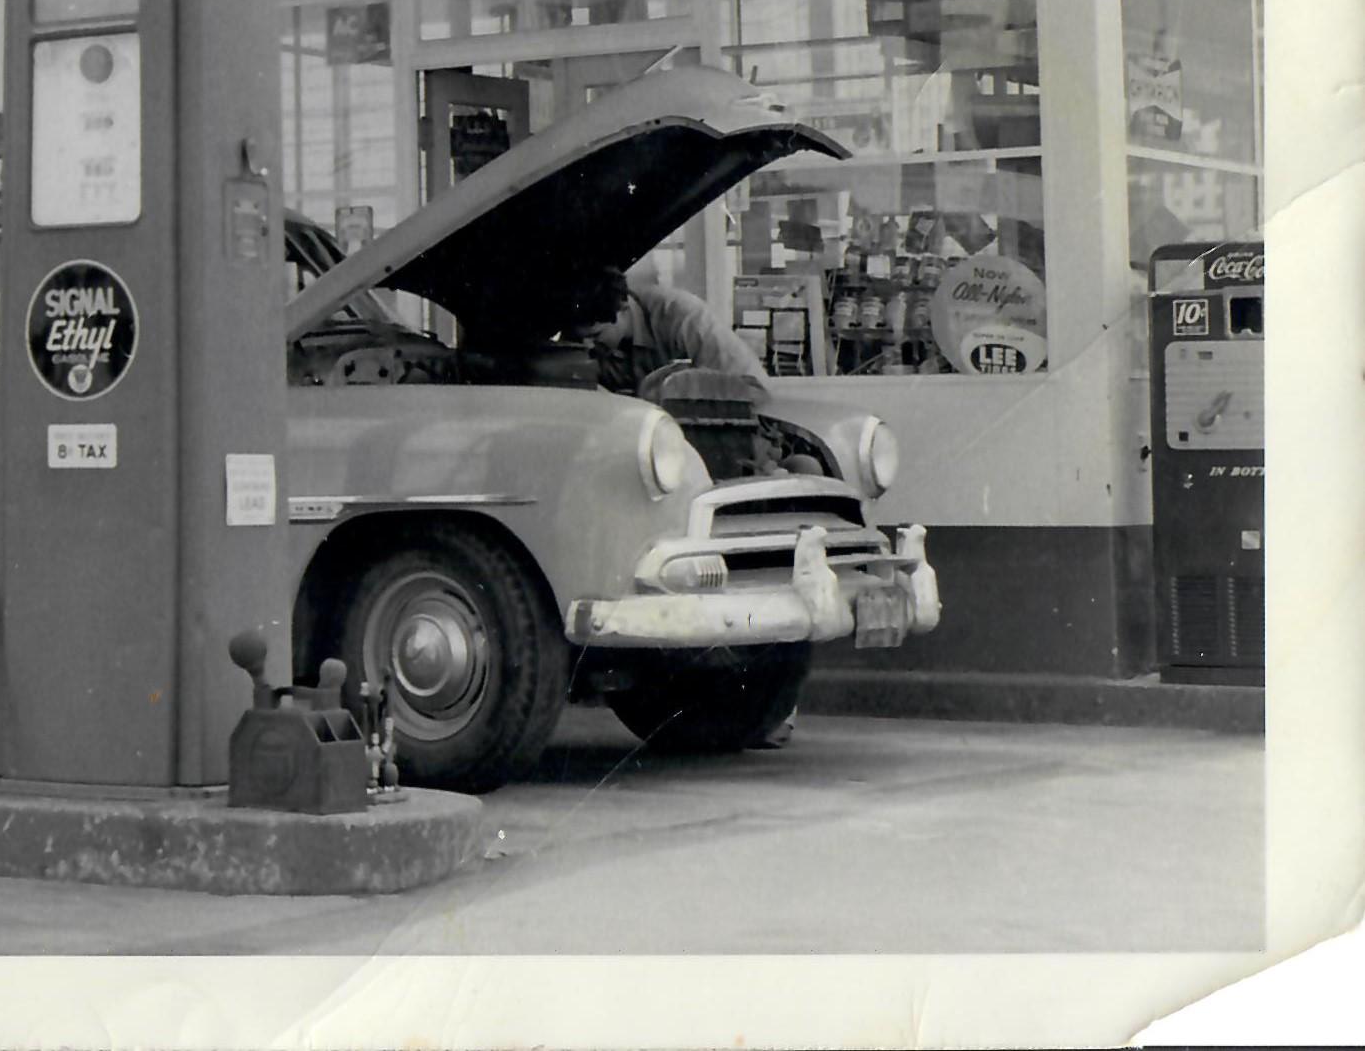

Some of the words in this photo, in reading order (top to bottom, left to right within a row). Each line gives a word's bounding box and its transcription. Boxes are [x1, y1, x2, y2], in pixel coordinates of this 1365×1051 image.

[45, 286, 121, 318] SIGNAL
[45, 316, 117, 370] Ethyl
[979, 345, 1017, 367] LEE
[78, 444, 108, 459] TAX
[1209, 466, 1226, 476] IN
